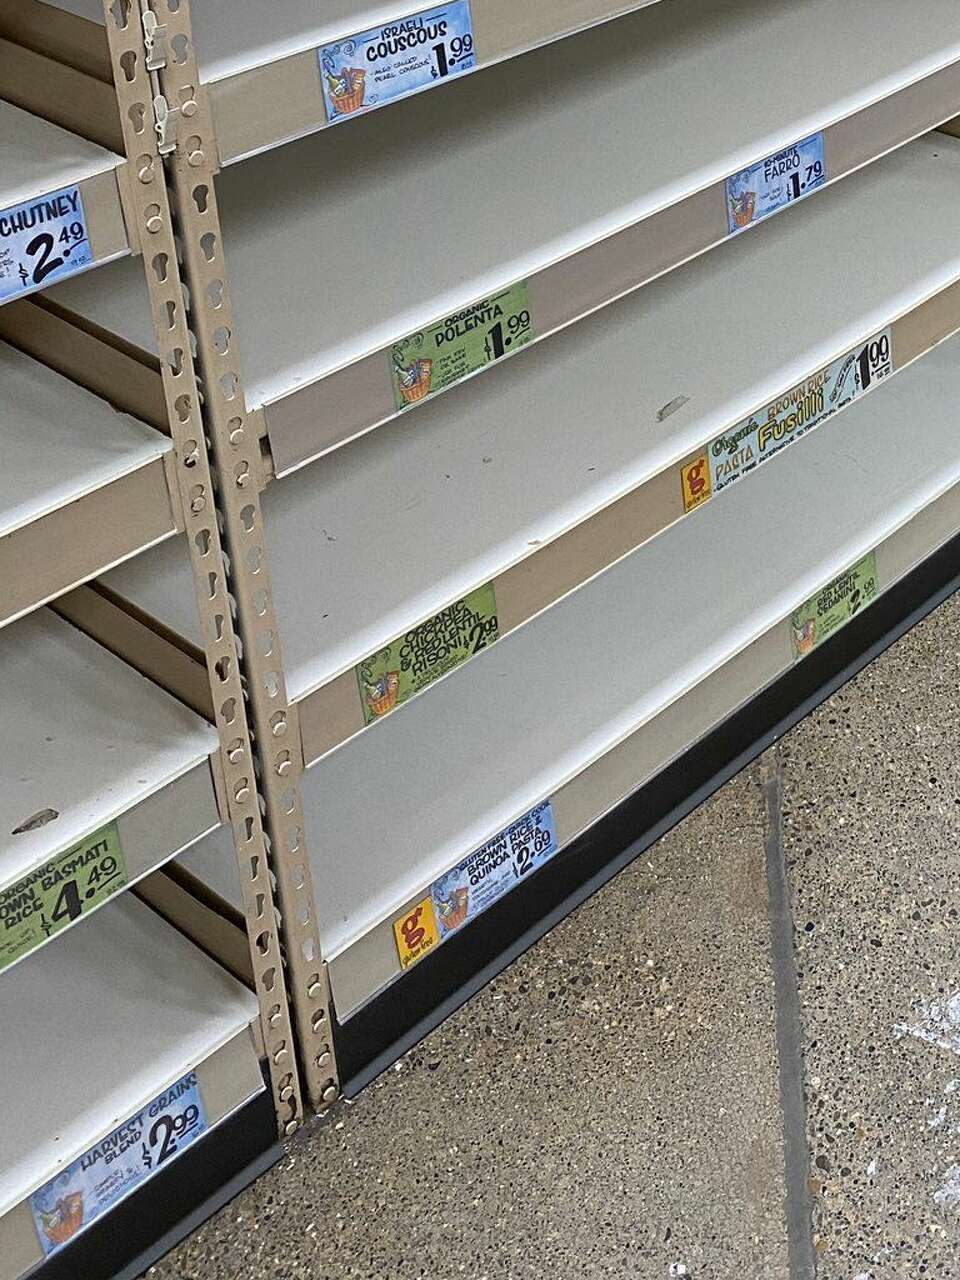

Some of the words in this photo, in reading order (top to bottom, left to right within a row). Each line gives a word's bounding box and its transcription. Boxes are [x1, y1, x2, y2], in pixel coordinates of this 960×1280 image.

[366, 20, 448, 63] COUSCOUS
[381, 18, 423, 41] ISRAELI
[430, 33, 473, 80] $1.99
[764, 154, 800, 183] FARRO
[786, 160, 822, 201] $1.79
[0, 190, 78, 237] CHUTNEY
[19, 221, 84, 286] $2.49
[435, 304, 504, 347] POLENTA
[444, 300, 490, 328] ORGANIC
[484, 310, 530, 360] $1.99
[854, 334, 890, 390] $1.99
[767, 388, 806, 420] BROWN
[808, 371, 831, 395] RICE
[715, 445, 753, 482] PASTA
[400, 608, 472, 659] CHICKPEA
[405, 600, 465, 645] ORGANIC
[415, 638, 441, 662] RED
[442, 612, 486, 641] LENTIL
[463, 615, 499, 655] $2.99
[412, 635, 462, 676] RISONI
[41, 839, 109, 892] BASMATI
[459, 847, 488, 872] GLUTEN
[467, 839, 508, 877] BROWN
[510, 820, 534, 844] RICE
[469, 851, 511, 886] QUINOA
[511, 827, 543, 855] PASTA
[512, 830, 551, 879] $2.69
[4, 897, 44, 930] RICE
[41, 856, 117, 937] $4.49
[80, 1112, 145, 1173] HARVEST
[148, 1073, 198, 1118] GRAINS
[141, 1104, 200, 1169] $2.99
[104, 1131, 143, 1166] BLEND
